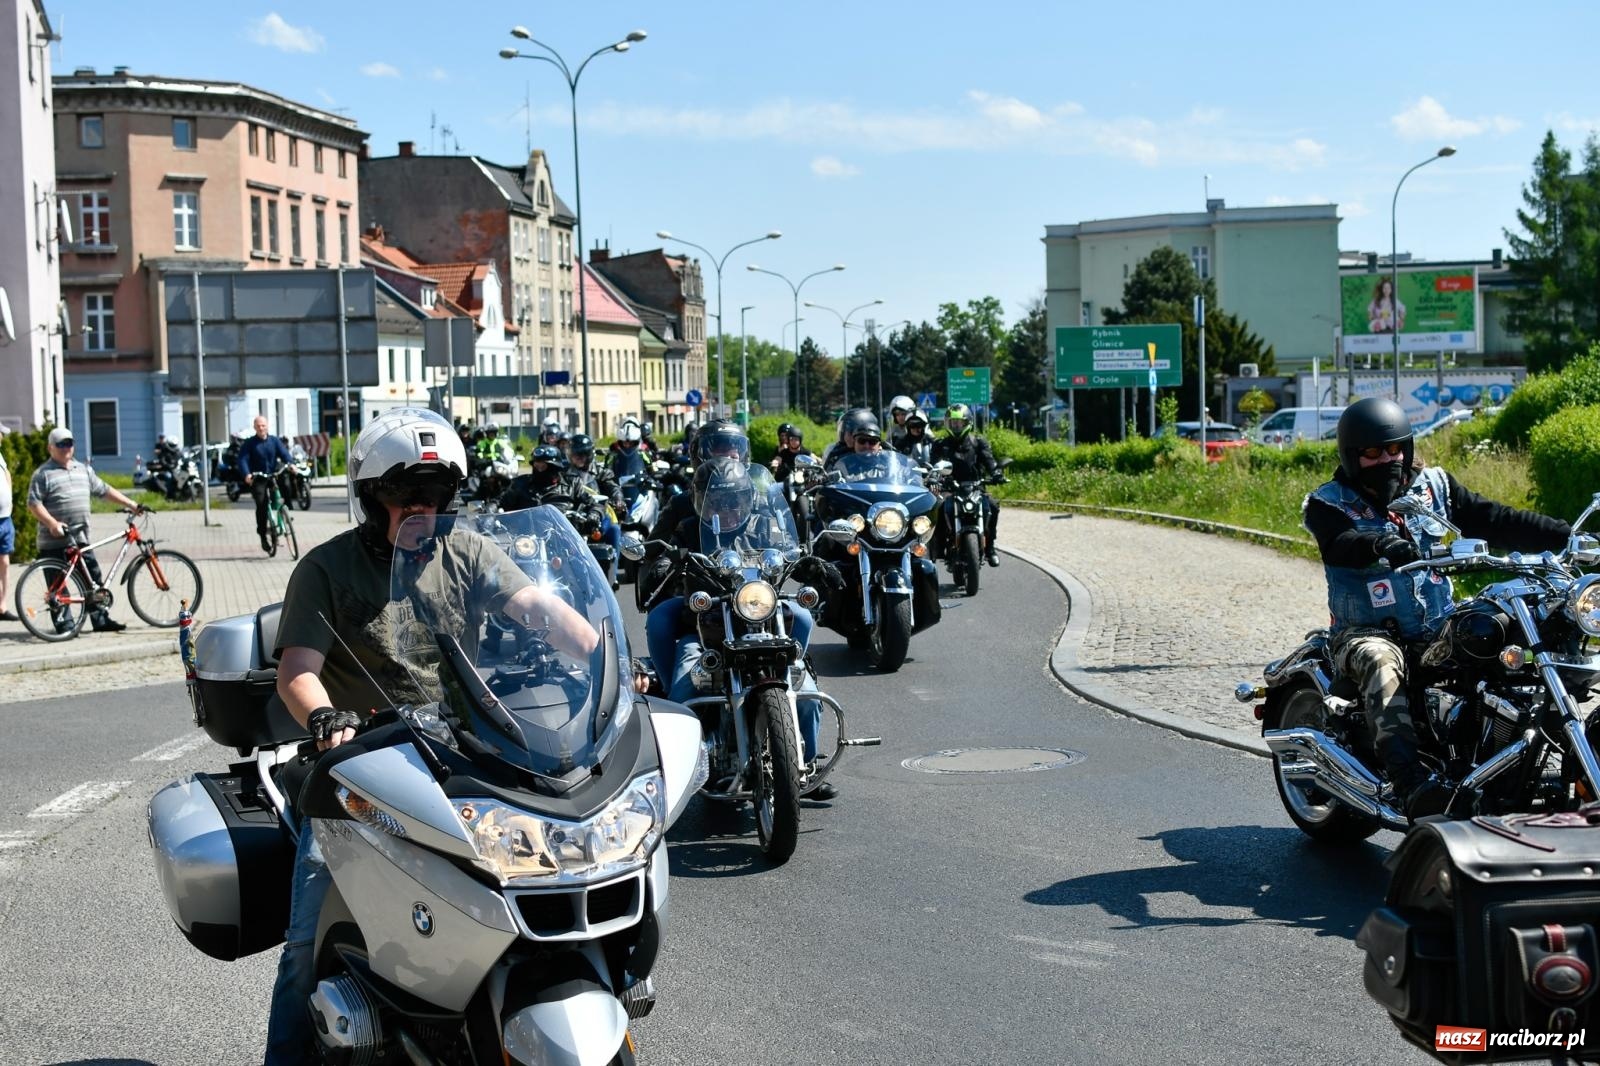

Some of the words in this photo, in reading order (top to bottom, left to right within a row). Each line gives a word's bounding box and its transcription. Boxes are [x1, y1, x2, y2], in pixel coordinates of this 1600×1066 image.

[1092, 328, 1121, 338] Rybnik
[1092, 340, 1124, 348] Gliwice
[1092, 376, 1120, 385] Opole
[1375, 599, 1393, 607] TOTAL
